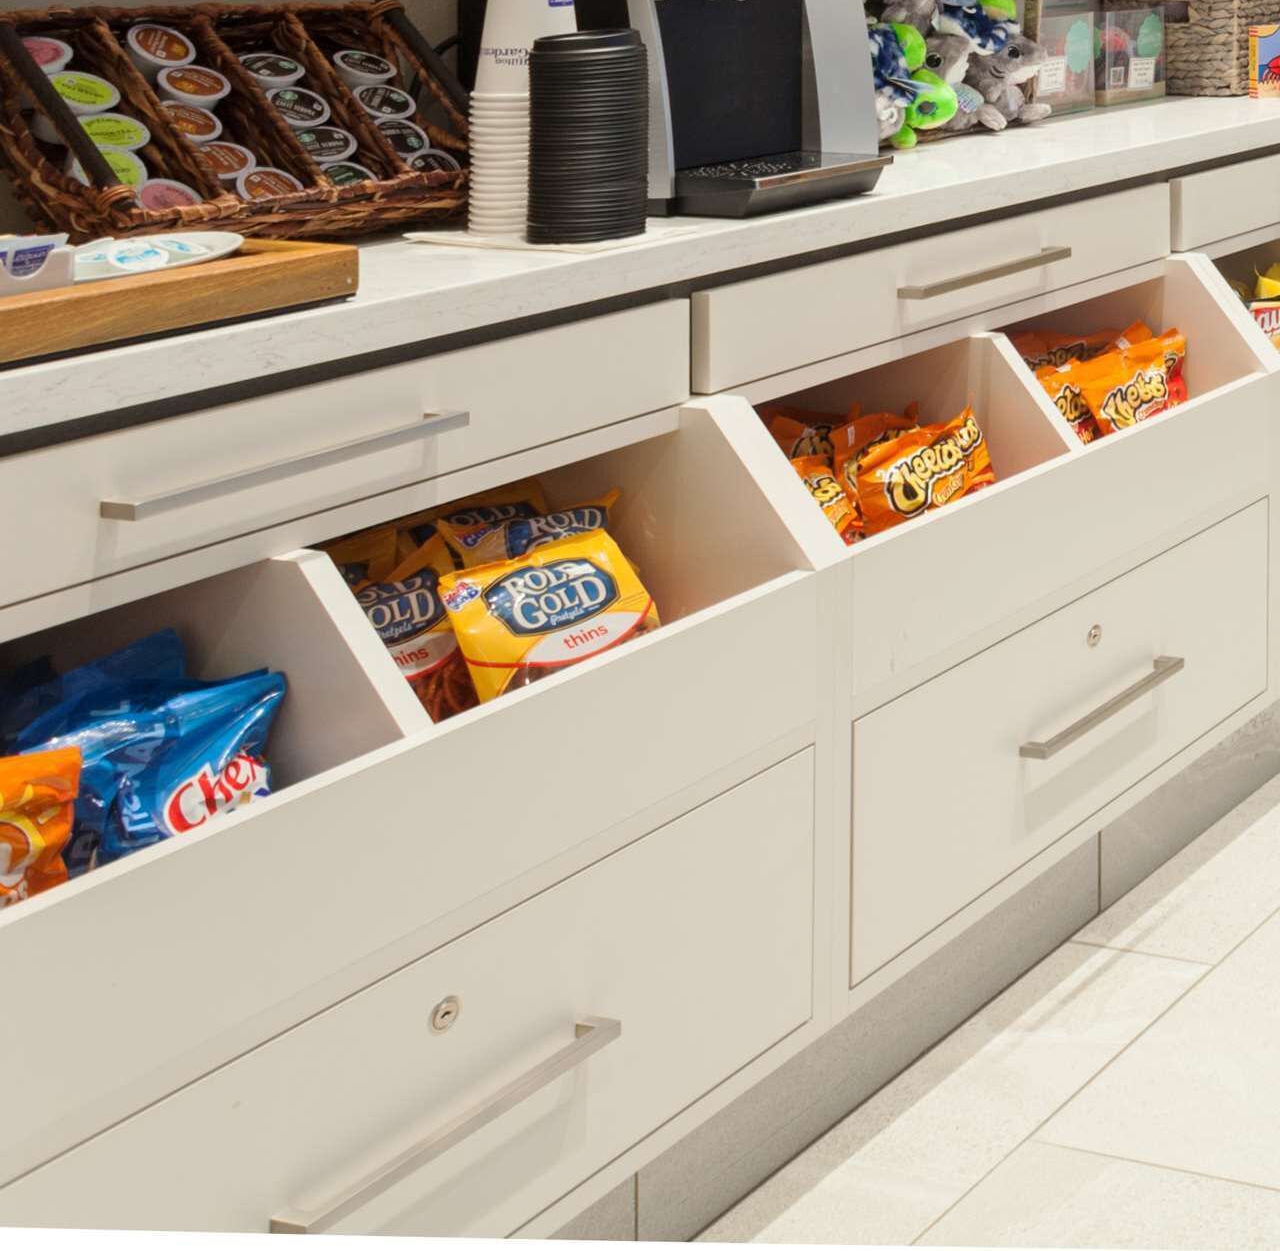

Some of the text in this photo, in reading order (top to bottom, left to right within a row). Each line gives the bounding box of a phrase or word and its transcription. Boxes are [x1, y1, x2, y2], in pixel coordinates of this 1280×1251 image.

[450, 503, 518, 526] OLD
[530, 507, 602, 536] ROLD
[368, 589, 435, 630] OLD
[512, 575, 607, 630] GOLD
[550, 606, 585, 626] Pretzels
[563, 623, 609, 650] thins
[393, 646, 430, 668] hins
[164, 750, 264, 834] Chex
